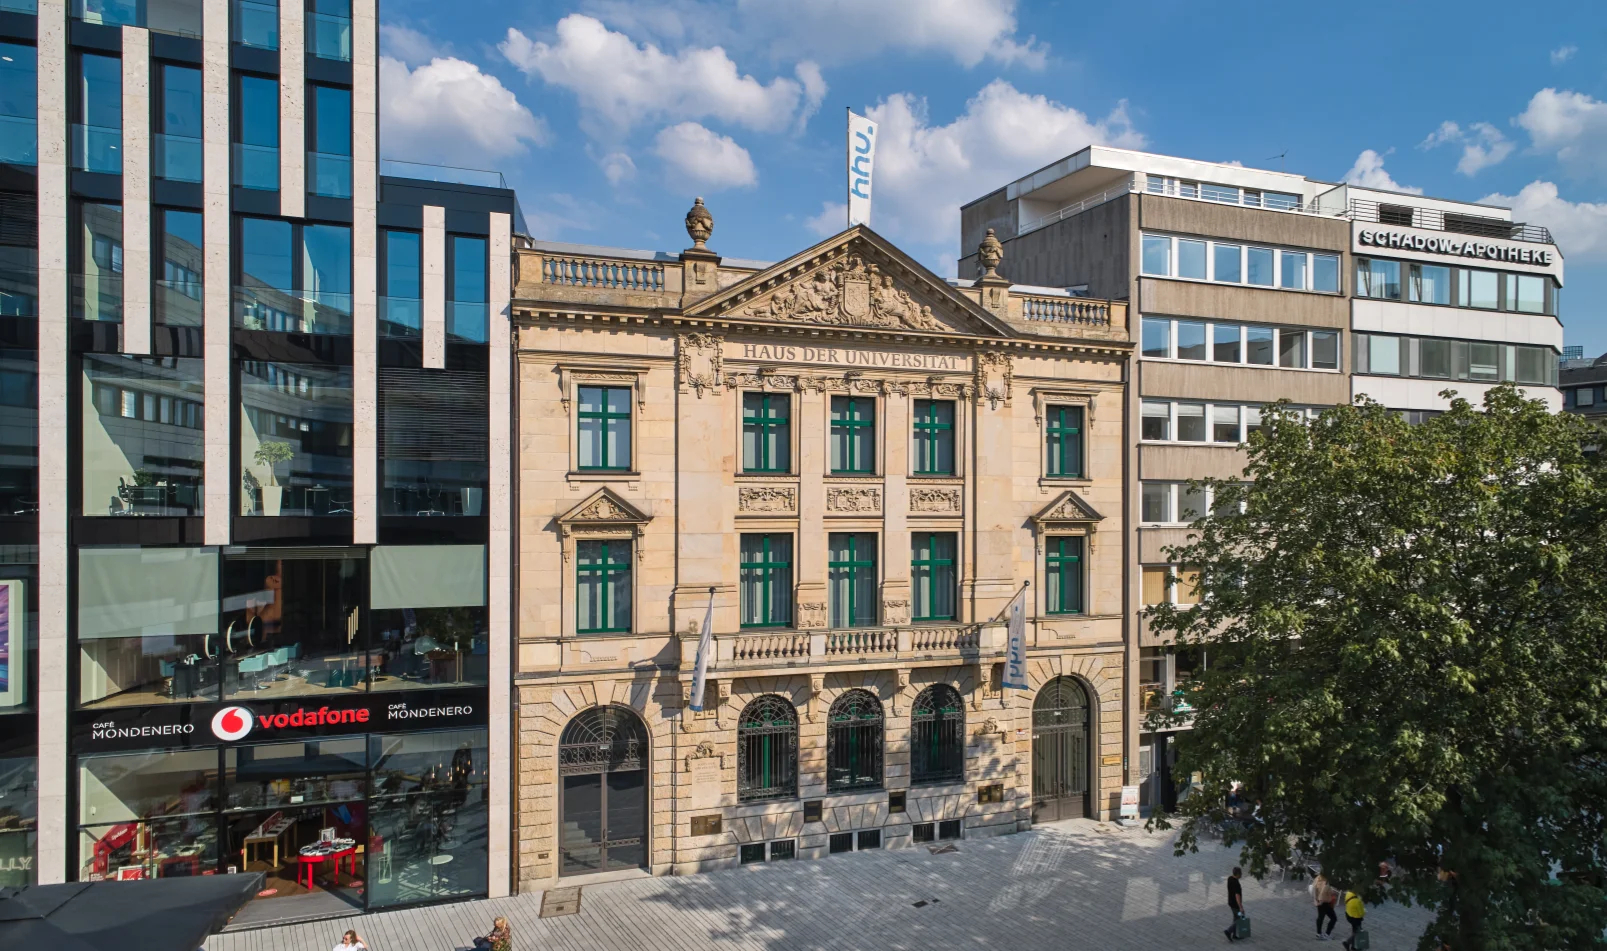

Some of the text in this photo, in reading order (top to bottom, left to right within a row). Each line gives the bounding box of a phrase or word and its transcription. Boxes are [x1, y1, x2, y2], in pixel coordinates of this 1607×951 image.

[851, 126, 873, 199] hhu.
[1361, 229, 1553, 264] SCHADOW-APOTHEKE
[743, 344, 959, 370] HAUS DER UNIVERSITÄT
[260, 706, 370, 729] vodafone
[388, 706, 473, 720] MONDENERO
[93, 721, 115, 729] CAFÉ
[93, 724, 195, 740] MONDENERO
